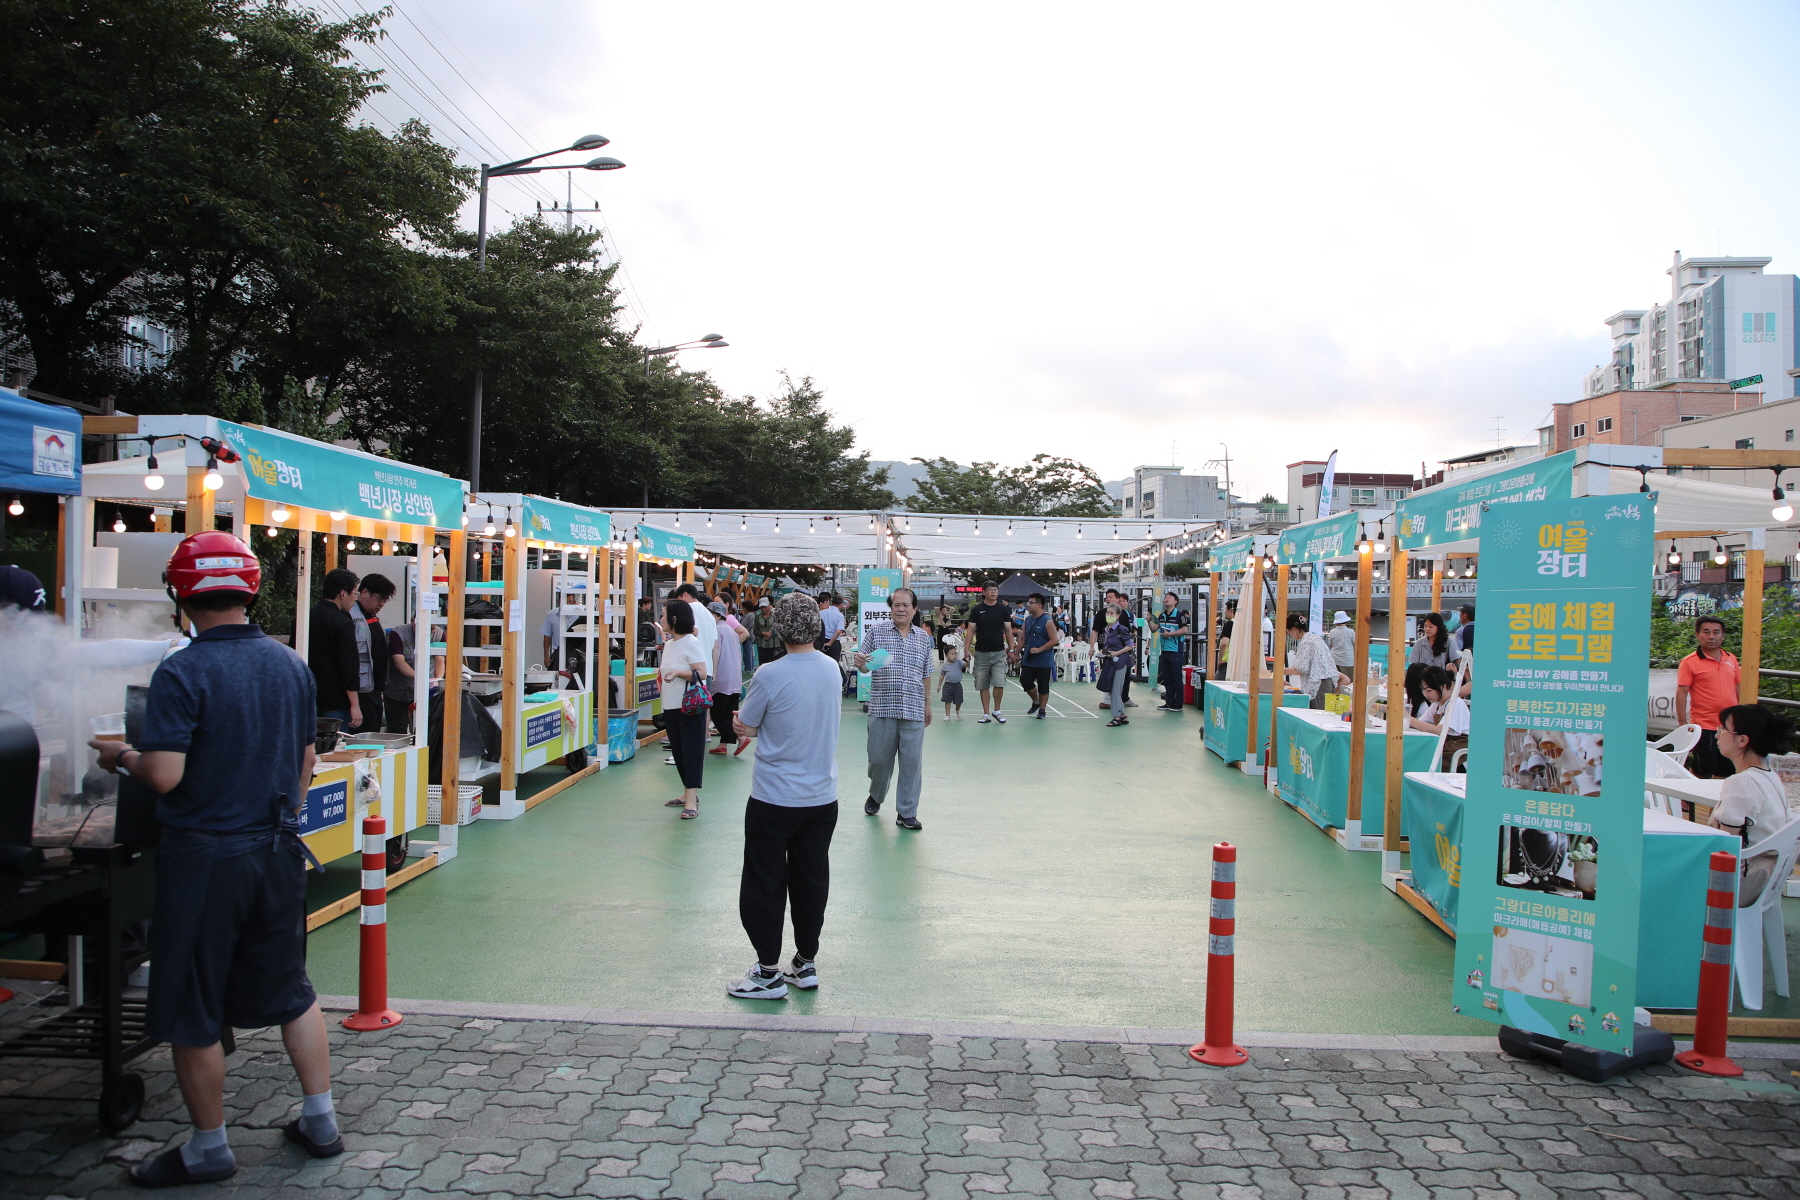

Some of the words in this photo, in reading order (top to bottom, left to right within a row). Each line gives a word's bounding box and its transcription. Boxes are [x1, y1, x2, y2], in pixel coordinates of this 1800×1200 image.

[248, 454, 278, 486] 여울
[274, 459, 302, 490] 장터
[404, 477, 417, 489] 먹거리
[358, 482, 402, 513] 백년시장
[404, 492, 436, 517] 상인회
[1622, 504, 1640, 520] 강북
[1412, 514, 1426, 534] 장터
[1538, 524, 1588, 553] 여울
[1536, 550, 1587, 578] 장터
[871, 577, 889, 588] 여울
[871, 586, 889, 597] 장터
[1508, 603, 1557, 630] 공예
[1562, 602, 1615, 630] 체험
[1508, 634, 1612, 663] 프로그램
[1507, 669, 1532, 679] 나만의
[1534, 670, 1550, 679] DIY
[1552, 670, 1578, 680] 공예품
[1580, 671, 1608, 681] 만들기
[1492, 680, 1512, 688] 강북구
[1542, 682, 1562, 690] 공방을
[1564, 683, 1598, 691] 우이천에서
[1600, 684, 1624, 692] 만나다!
[1507, 699, 1606, 717] 행복한도자기공방
[1505, 715, 1531, 726] 도자기
[1533, 717, 1572, 728] 풍경/키링
[1575, 720, 1602, 730] 만들기
[1300, 747, 1314, 781] 장터
[323, 791, 344, 804] ₩7,000
[323, 804, 344, 818] ₩7,000
[1525, 800, 1576, 818] 은을담다
[1503, 813, 1511, 824] 은
[1514, 814, 1562, 829] 목걸이/팔찌
[1565, 820, 1592, 833] 만들기
[1435, 833, 1462, 888] 여울
[1495, 897, 1596, 926] 그랑디르아뜰리에
[1494, 913, 1571, 936] 마크라메(매듭공예)
[1574, 927, 1592, 940] 체험
